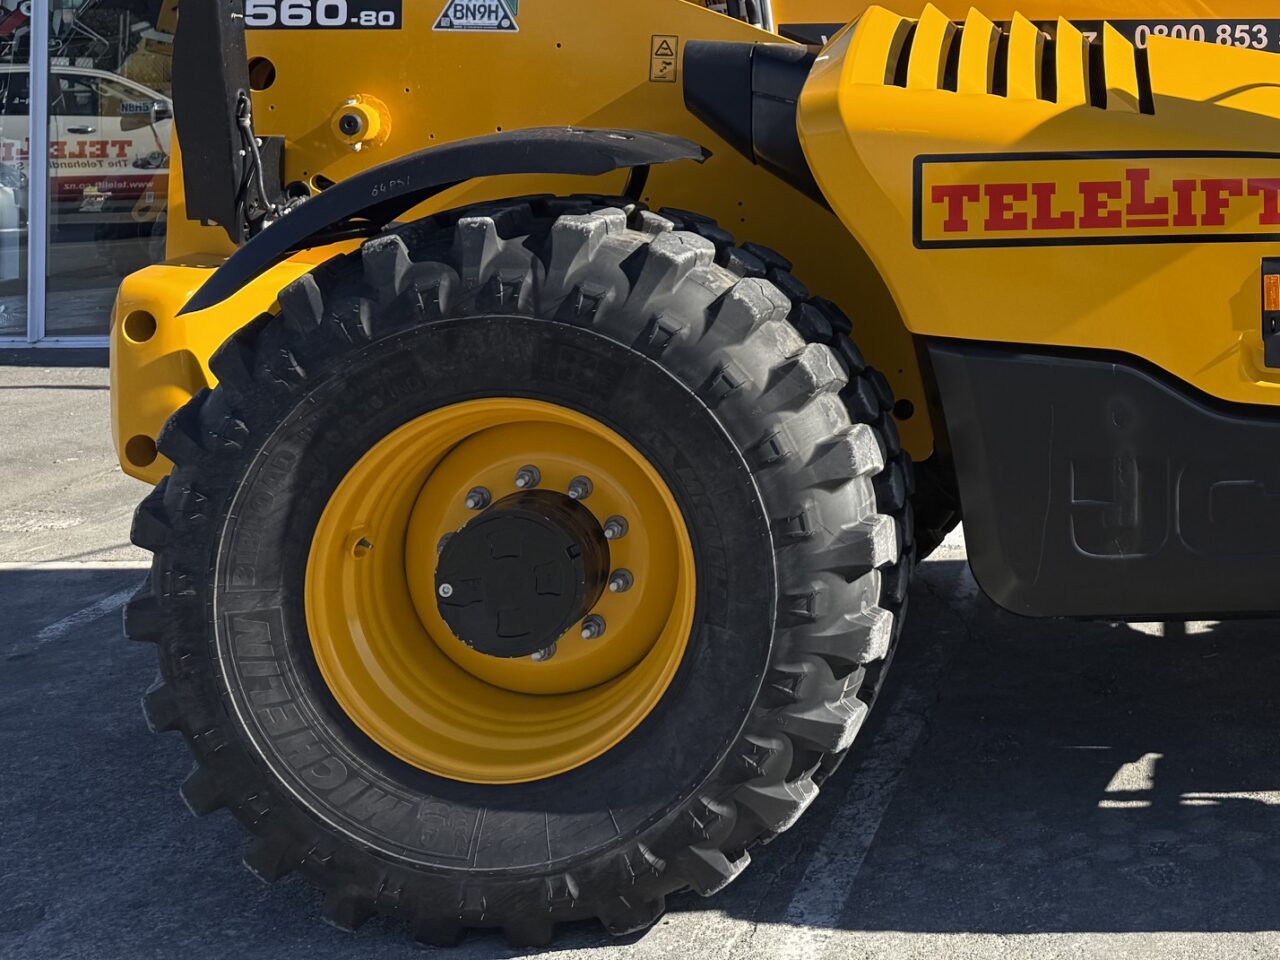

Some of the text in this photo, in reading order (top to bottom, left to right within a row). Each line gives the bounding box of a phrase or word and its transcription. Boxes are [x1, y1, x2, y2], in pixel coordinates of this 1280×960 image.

[453, 3, 499, 21] BN9H
[1216, 24, 1268, 49] 853
[233, 617, 416, 838] MICHELIN
